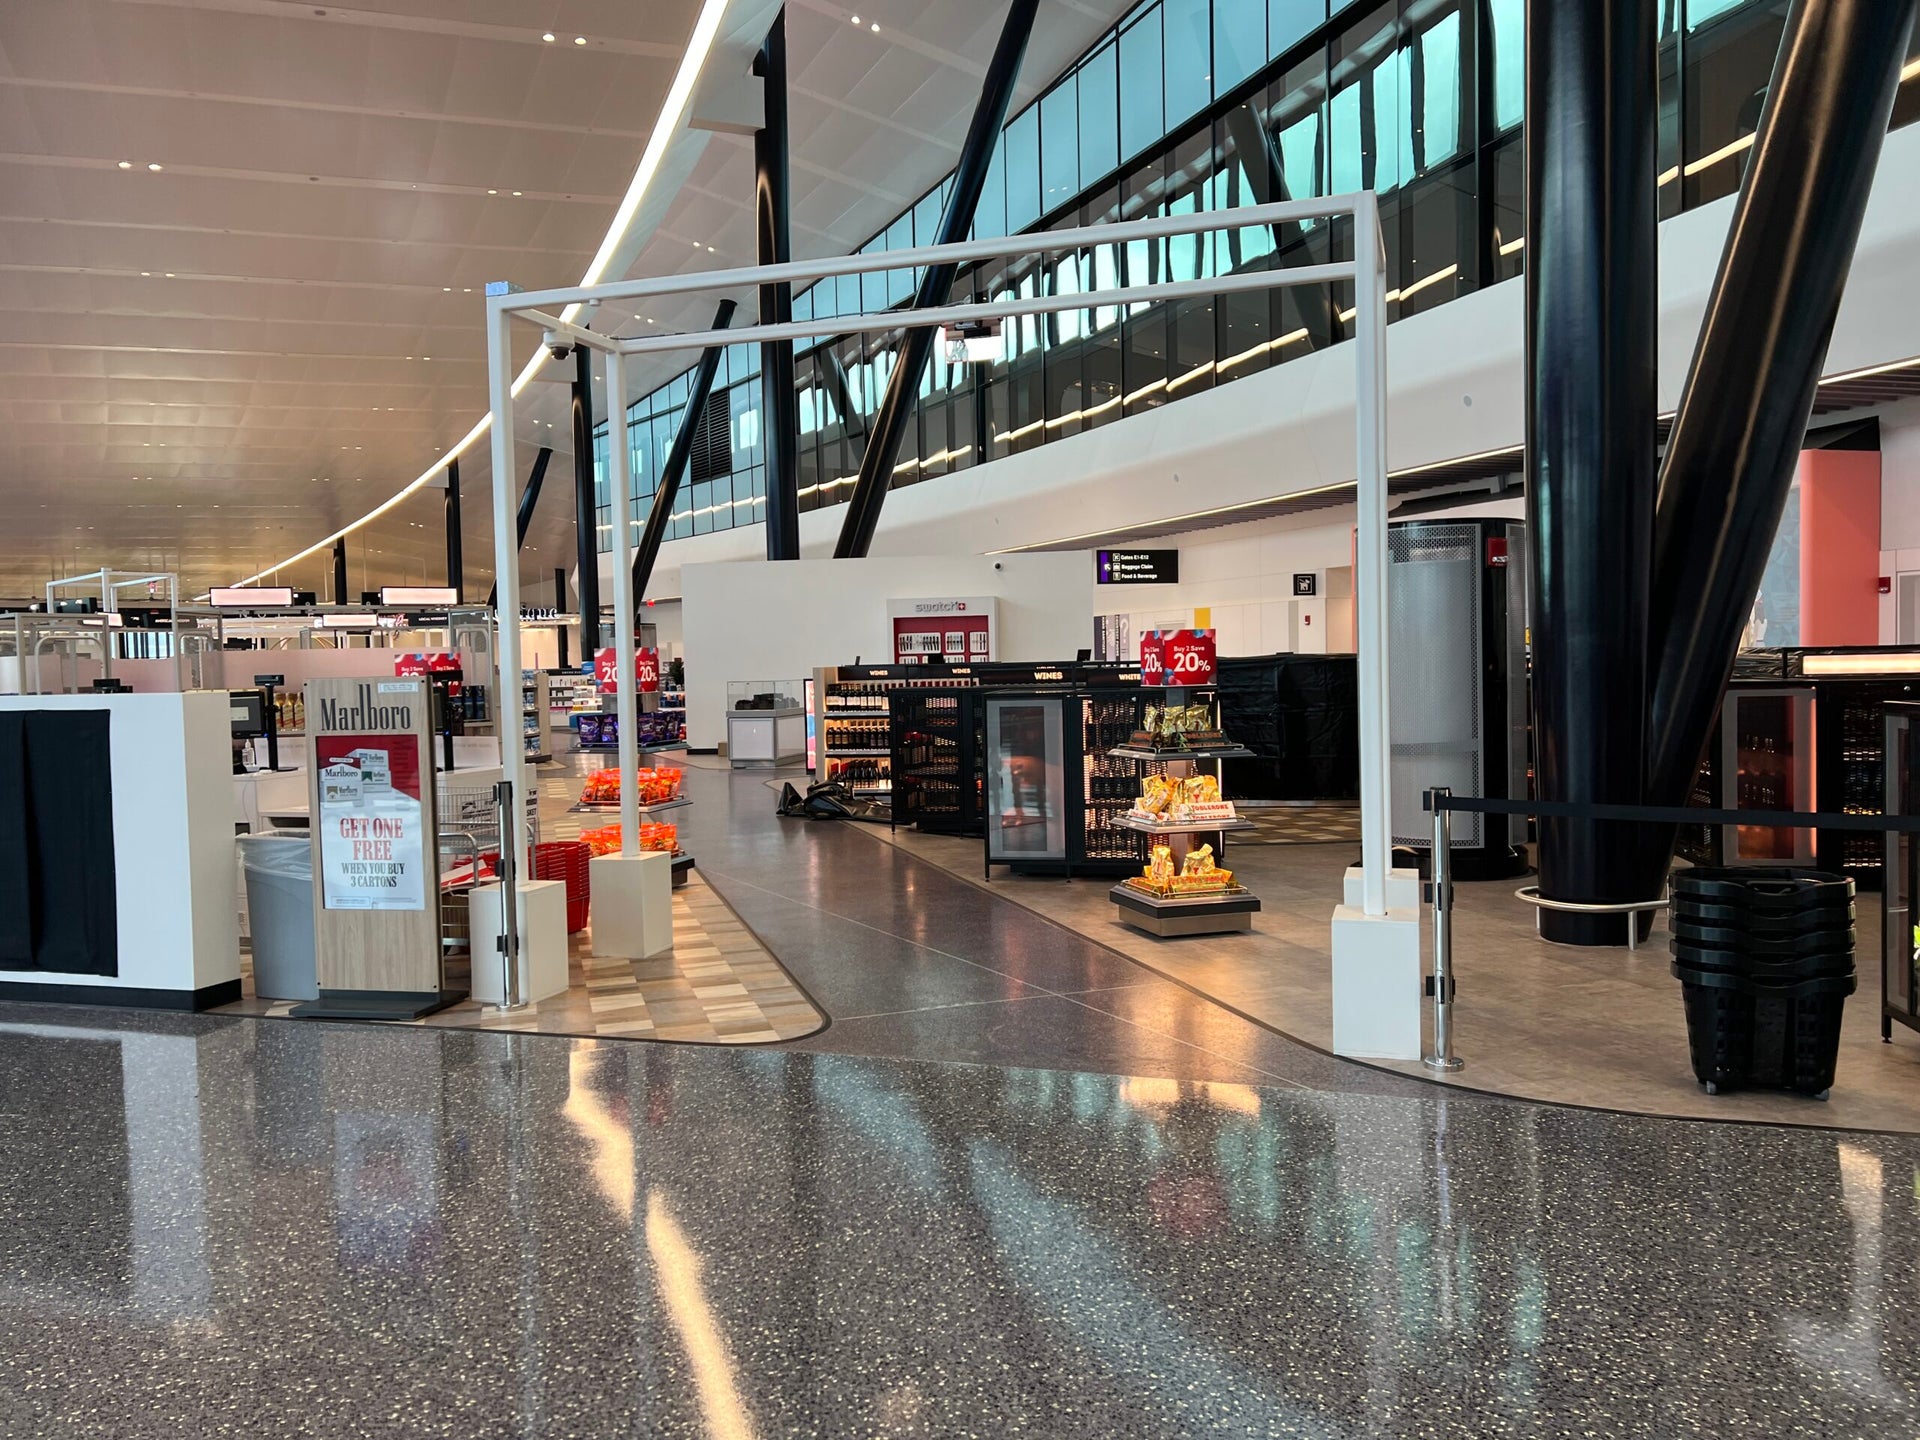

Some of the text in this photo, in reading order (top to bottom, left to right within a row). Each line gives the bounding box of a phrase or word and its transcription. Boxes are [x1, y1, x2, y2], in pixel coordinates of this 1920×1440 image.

[1173, 645, 1185, 653] Buy
[1144, 653, 1163, 673] 20%
[1173, 652, 1211, 672] 20%
[640, 665, 658, 683] 20%
[1034, 671, 1063, 681] WINES
[320, 684, 411, 731] Marlboro
[325, 766, 359, 778] Marlboro
[340, 818, 404, 839] GET ONE
[352, 840, 393, 861] FREE
[341, 863, 405, 875] WHEN YOU BUY
[351, 876, 397, 888] 3 CARTONS
